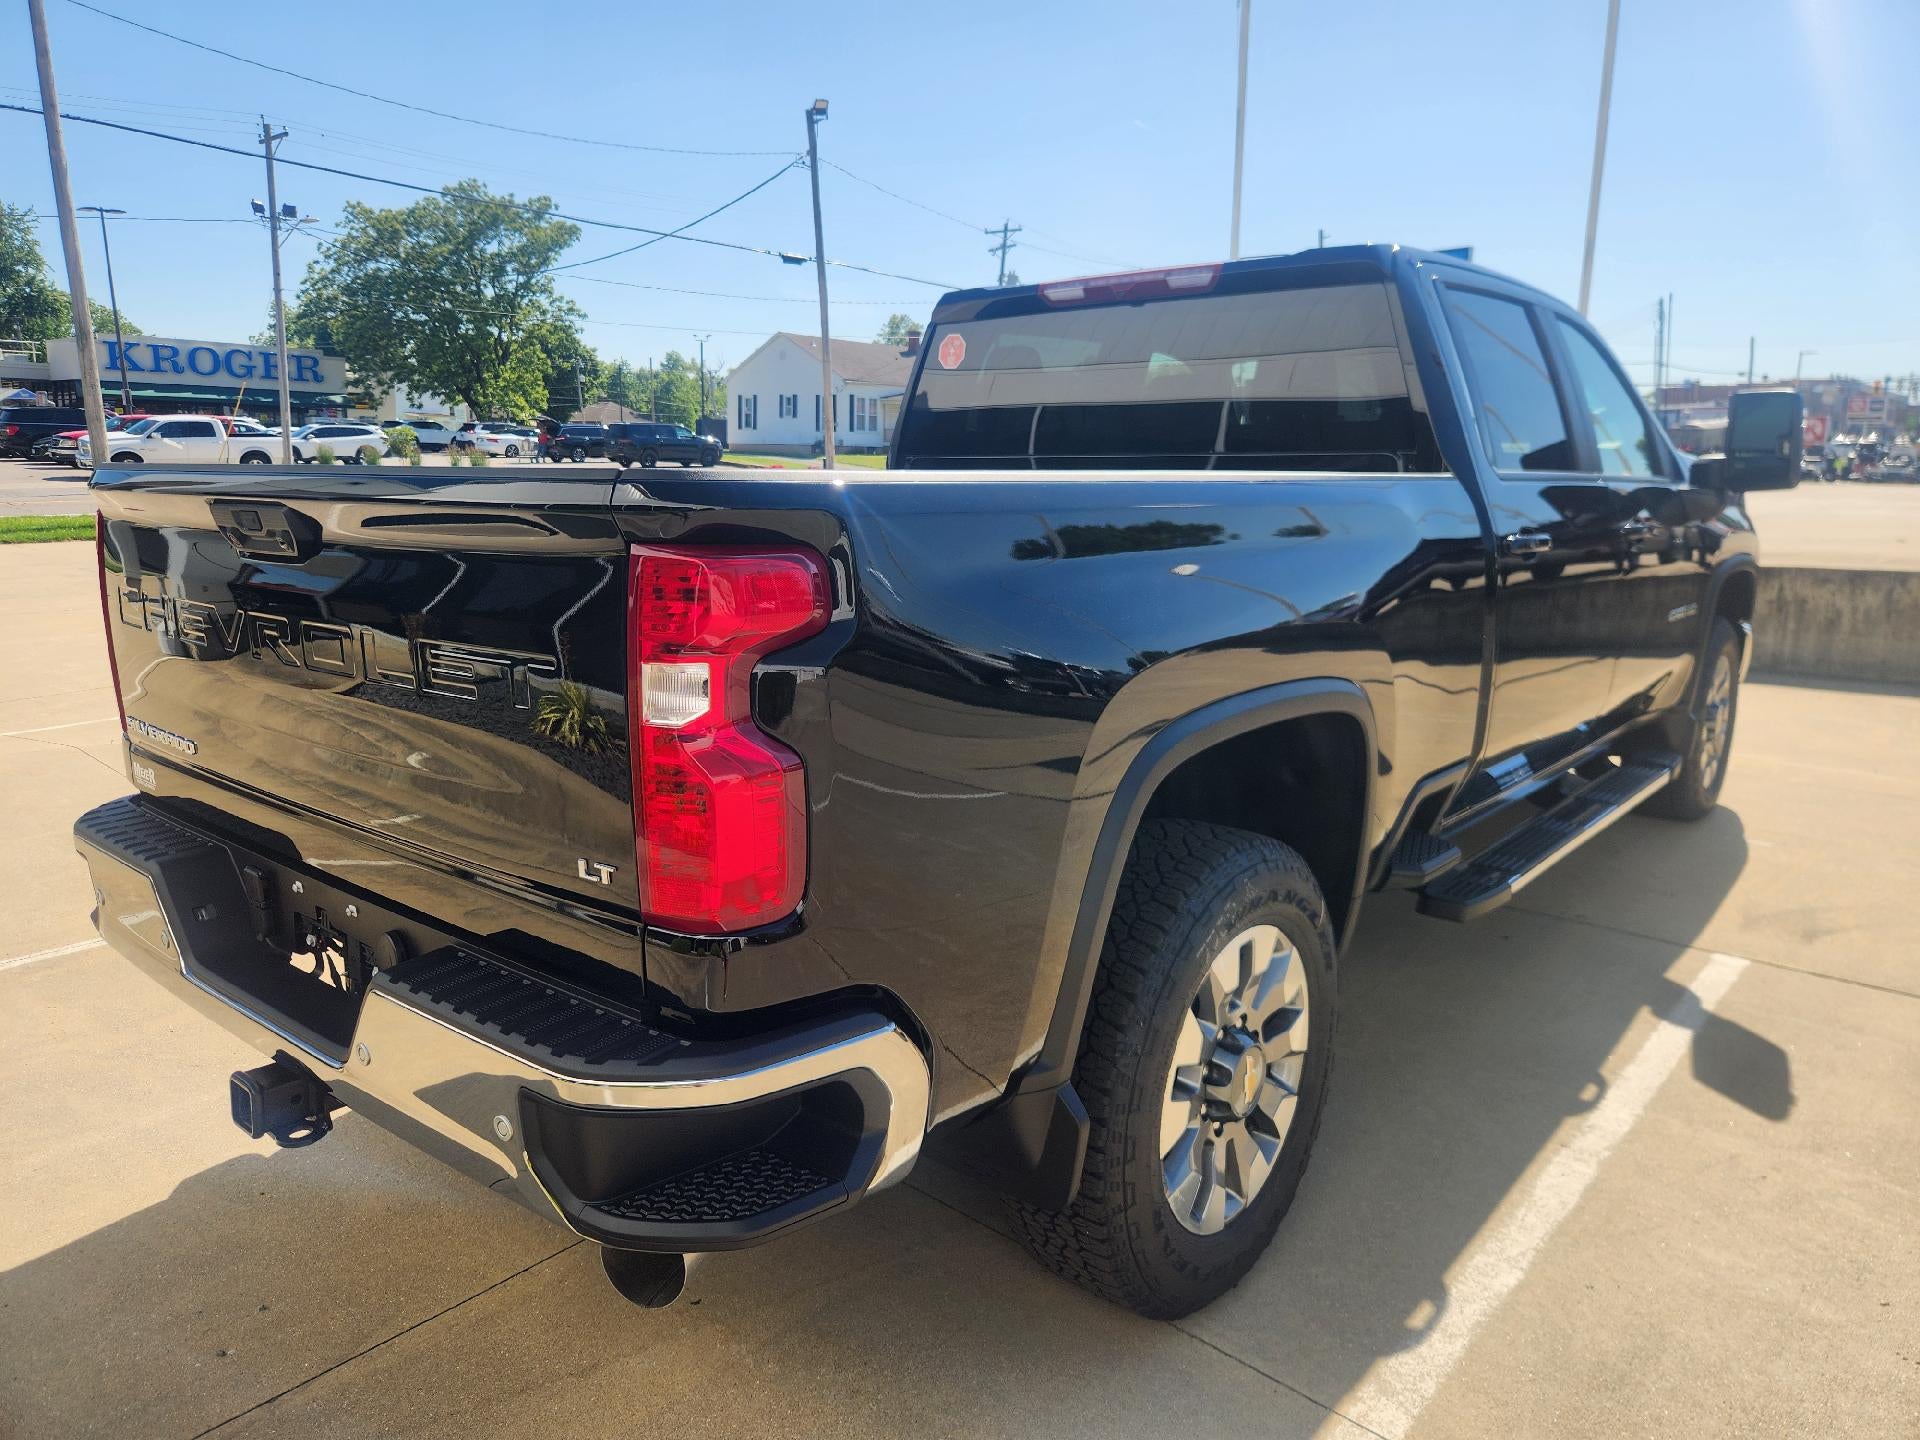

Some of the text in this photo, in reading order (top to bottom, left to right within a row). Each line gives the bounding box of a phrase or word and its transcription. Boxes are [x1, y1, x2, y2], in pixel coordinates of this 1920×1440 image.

[102, 340, 324, 384] KROGER
[118, 585, 557, 709] CHEVROLET
[578, 858, 617, 885] LT
